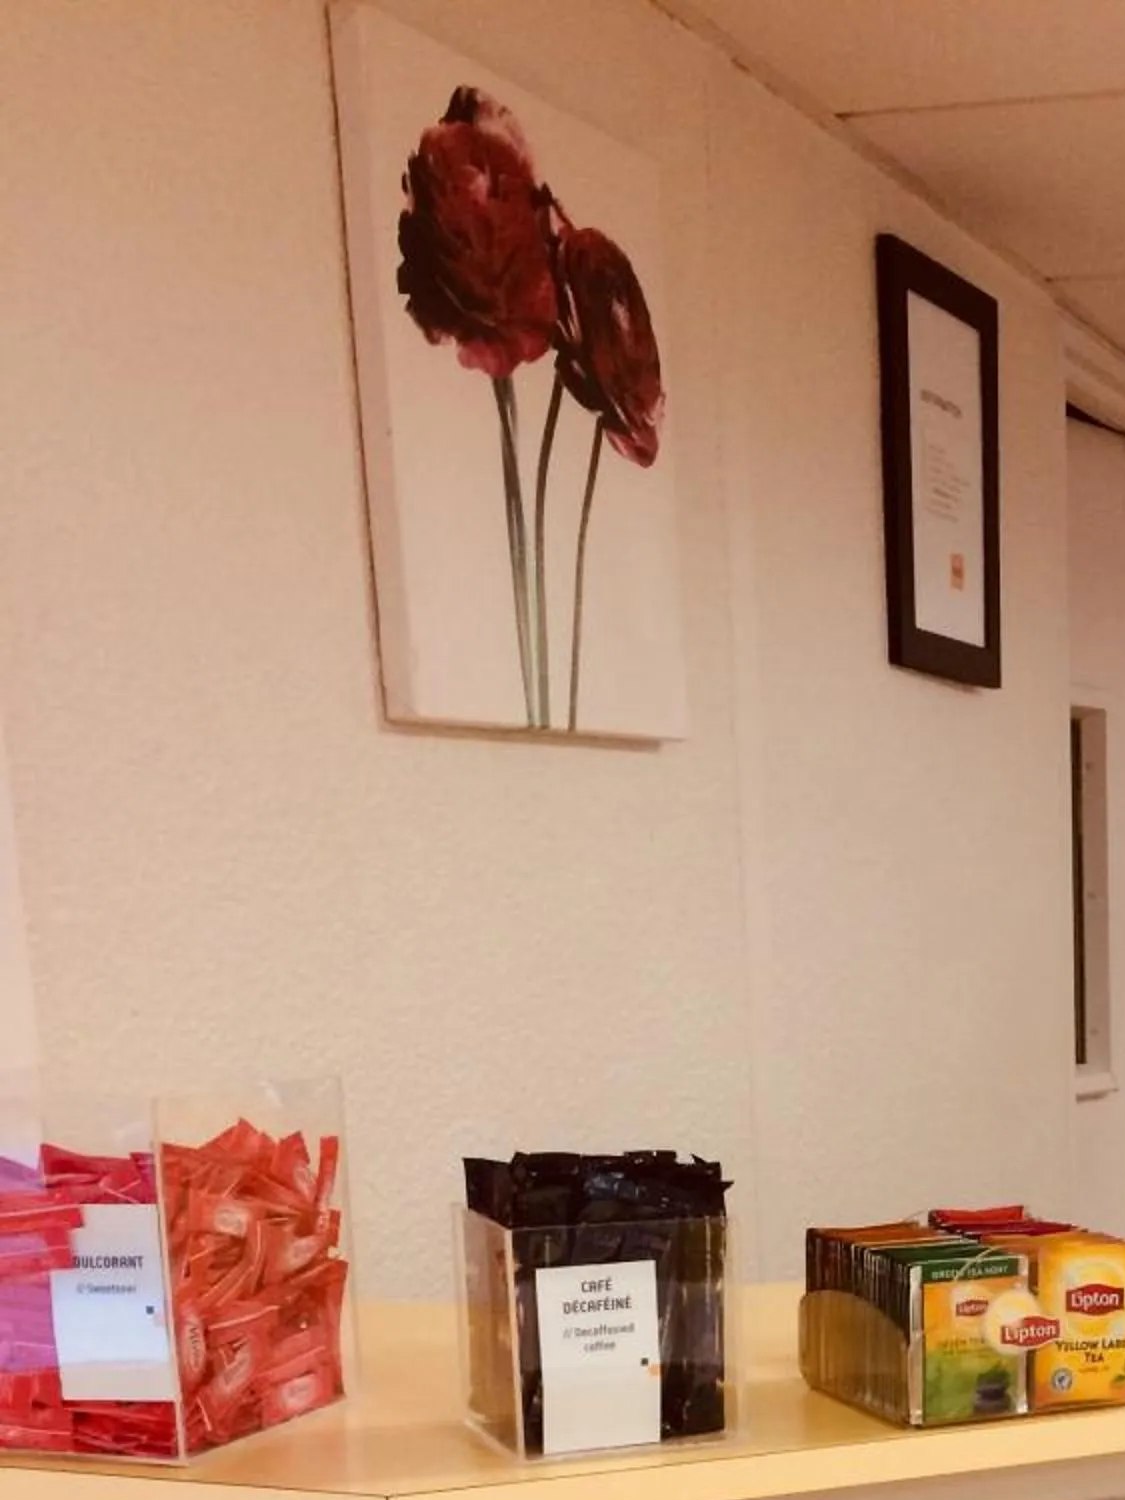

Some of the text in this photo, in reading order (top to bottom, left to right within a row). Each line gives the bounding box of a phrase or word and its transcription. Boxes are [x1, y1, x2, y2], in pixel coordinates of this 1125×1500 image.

[581, 1277, 613, 1293] CAFÉ
[1071, 1290, 1119, 1311] Lipton
[1005, 1324, 1056, 1343] Lipton
